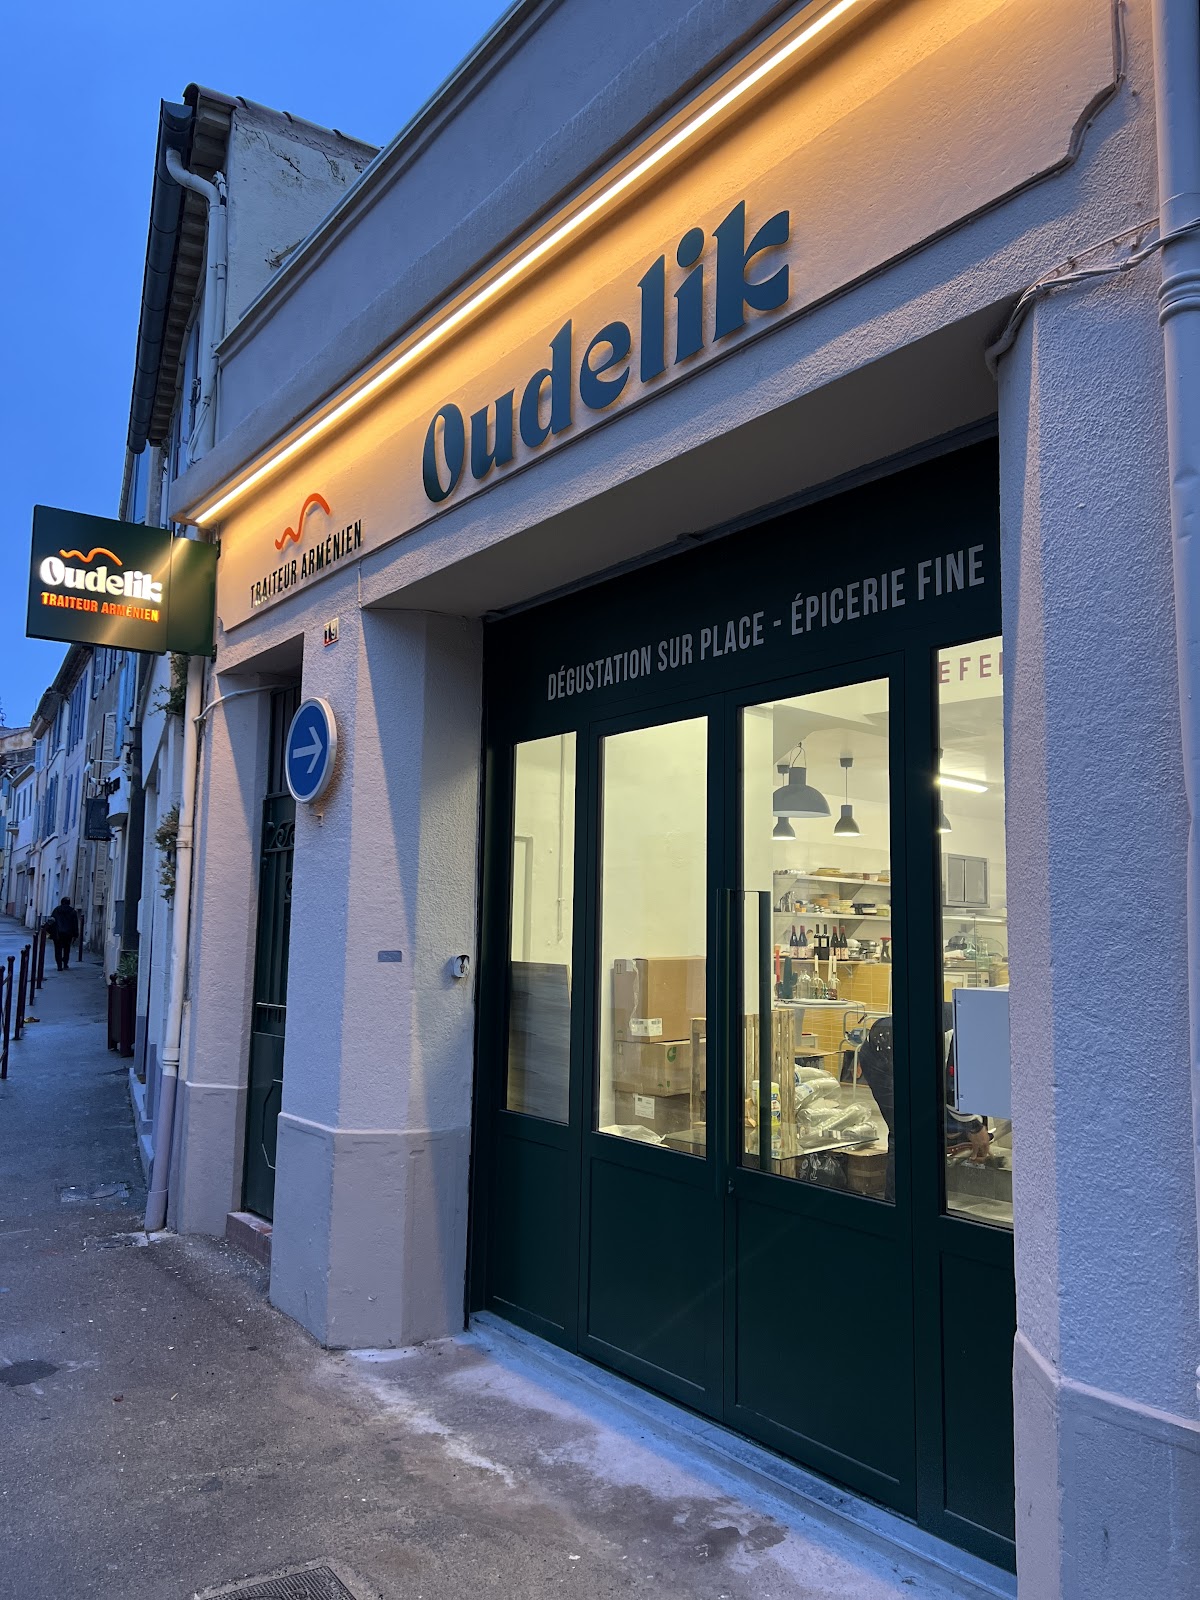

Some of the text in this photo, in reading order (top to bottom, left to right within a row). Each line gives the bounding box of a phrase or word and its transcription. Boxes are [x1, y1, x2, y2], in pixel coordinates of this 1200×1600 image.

[422, 199, 790, 503] Oudelik
[40, 556, 163, 603] Oudelik
[250, 518, 362, 609] TRAITEUR ARMÉNIEN
[41, 592, 160, 623] TRAITEUR ARMÉNIEN
[547, 644, 652, 701] DÉGUSTATION
[657, 633, 693, 672] SUR
[700, 611, 765, 661] PLACE
[790, 567, 906, 637] ÉPICERIE
[917, 544, 985, 601] FINE
[939, 651, 1003, 684] EFE
